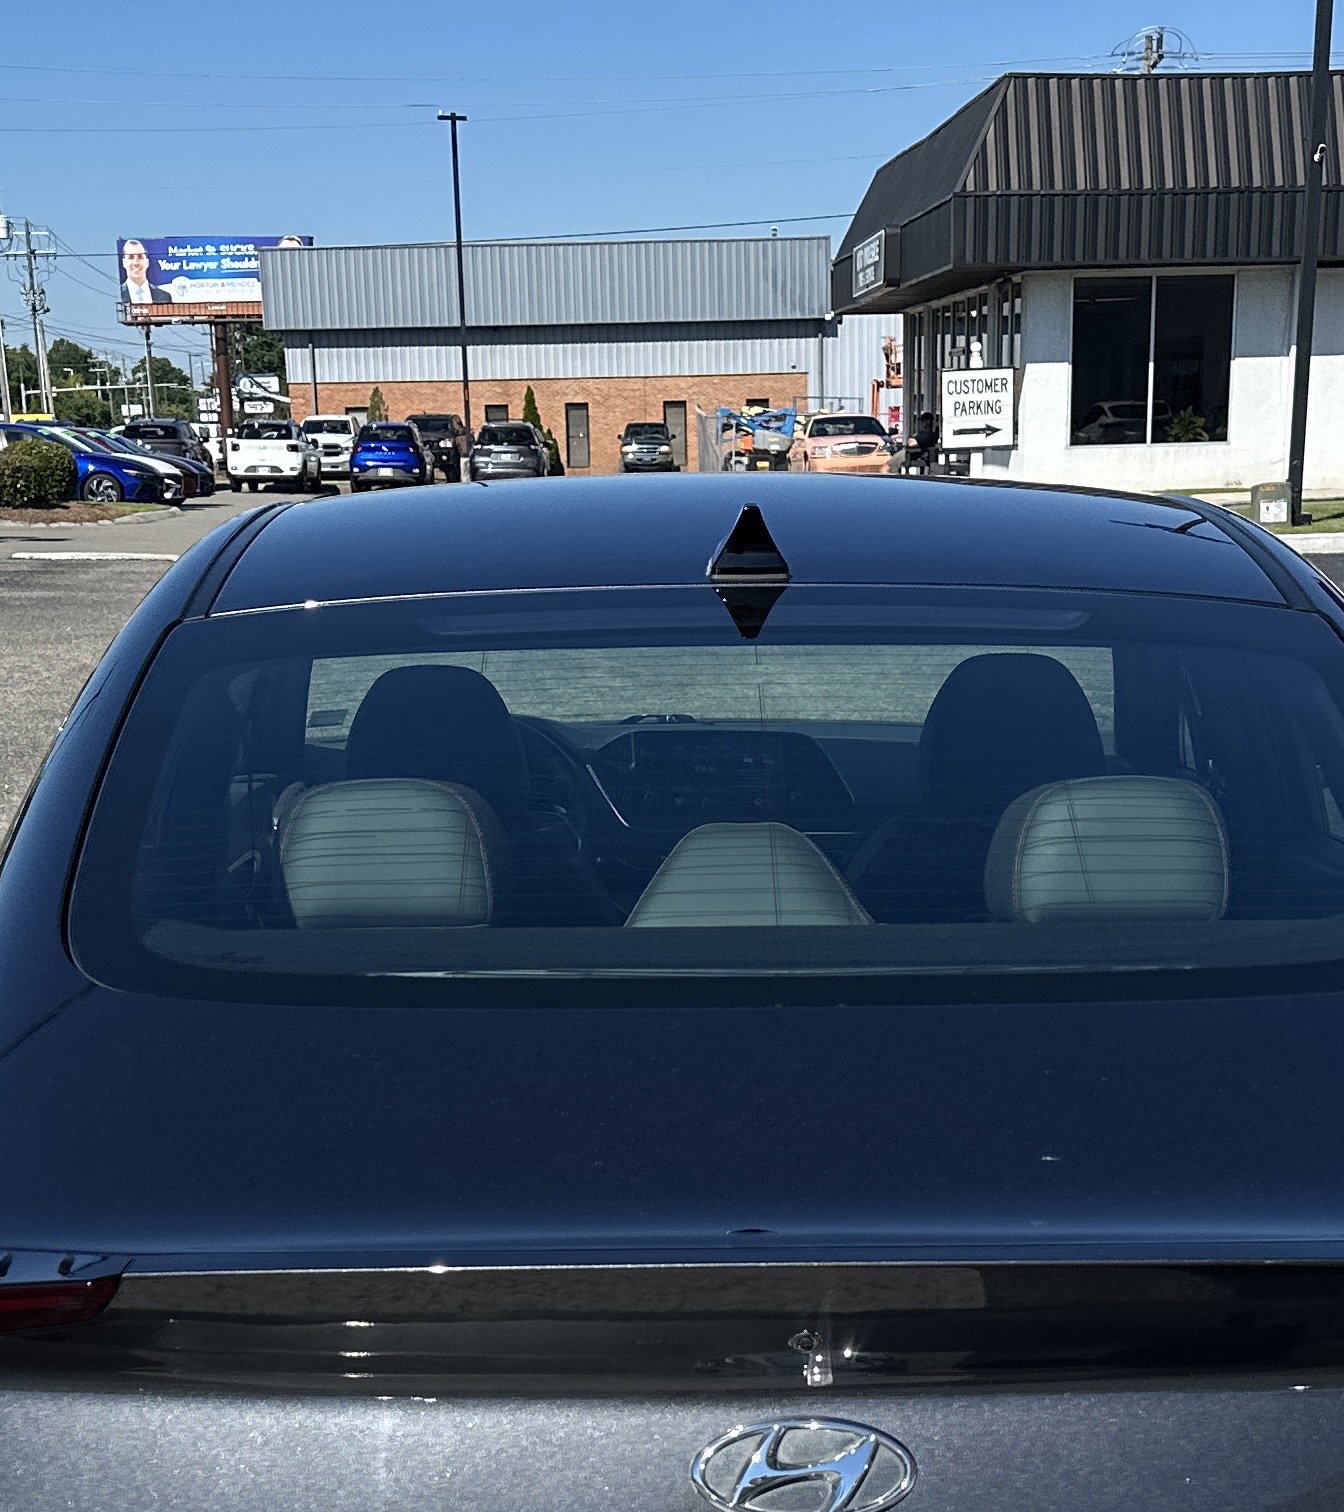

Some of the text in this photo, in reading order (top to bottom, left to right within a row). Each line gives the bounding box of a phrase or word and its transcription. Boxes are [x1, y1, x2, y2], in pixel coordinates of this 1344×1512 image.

[158, 259, 181, 271] Your
[182, 259, 219, 272] Lawyer
[947, 377, 1008, 395] CUSTOMER
[954, 399, 1002, 417] PARKING
